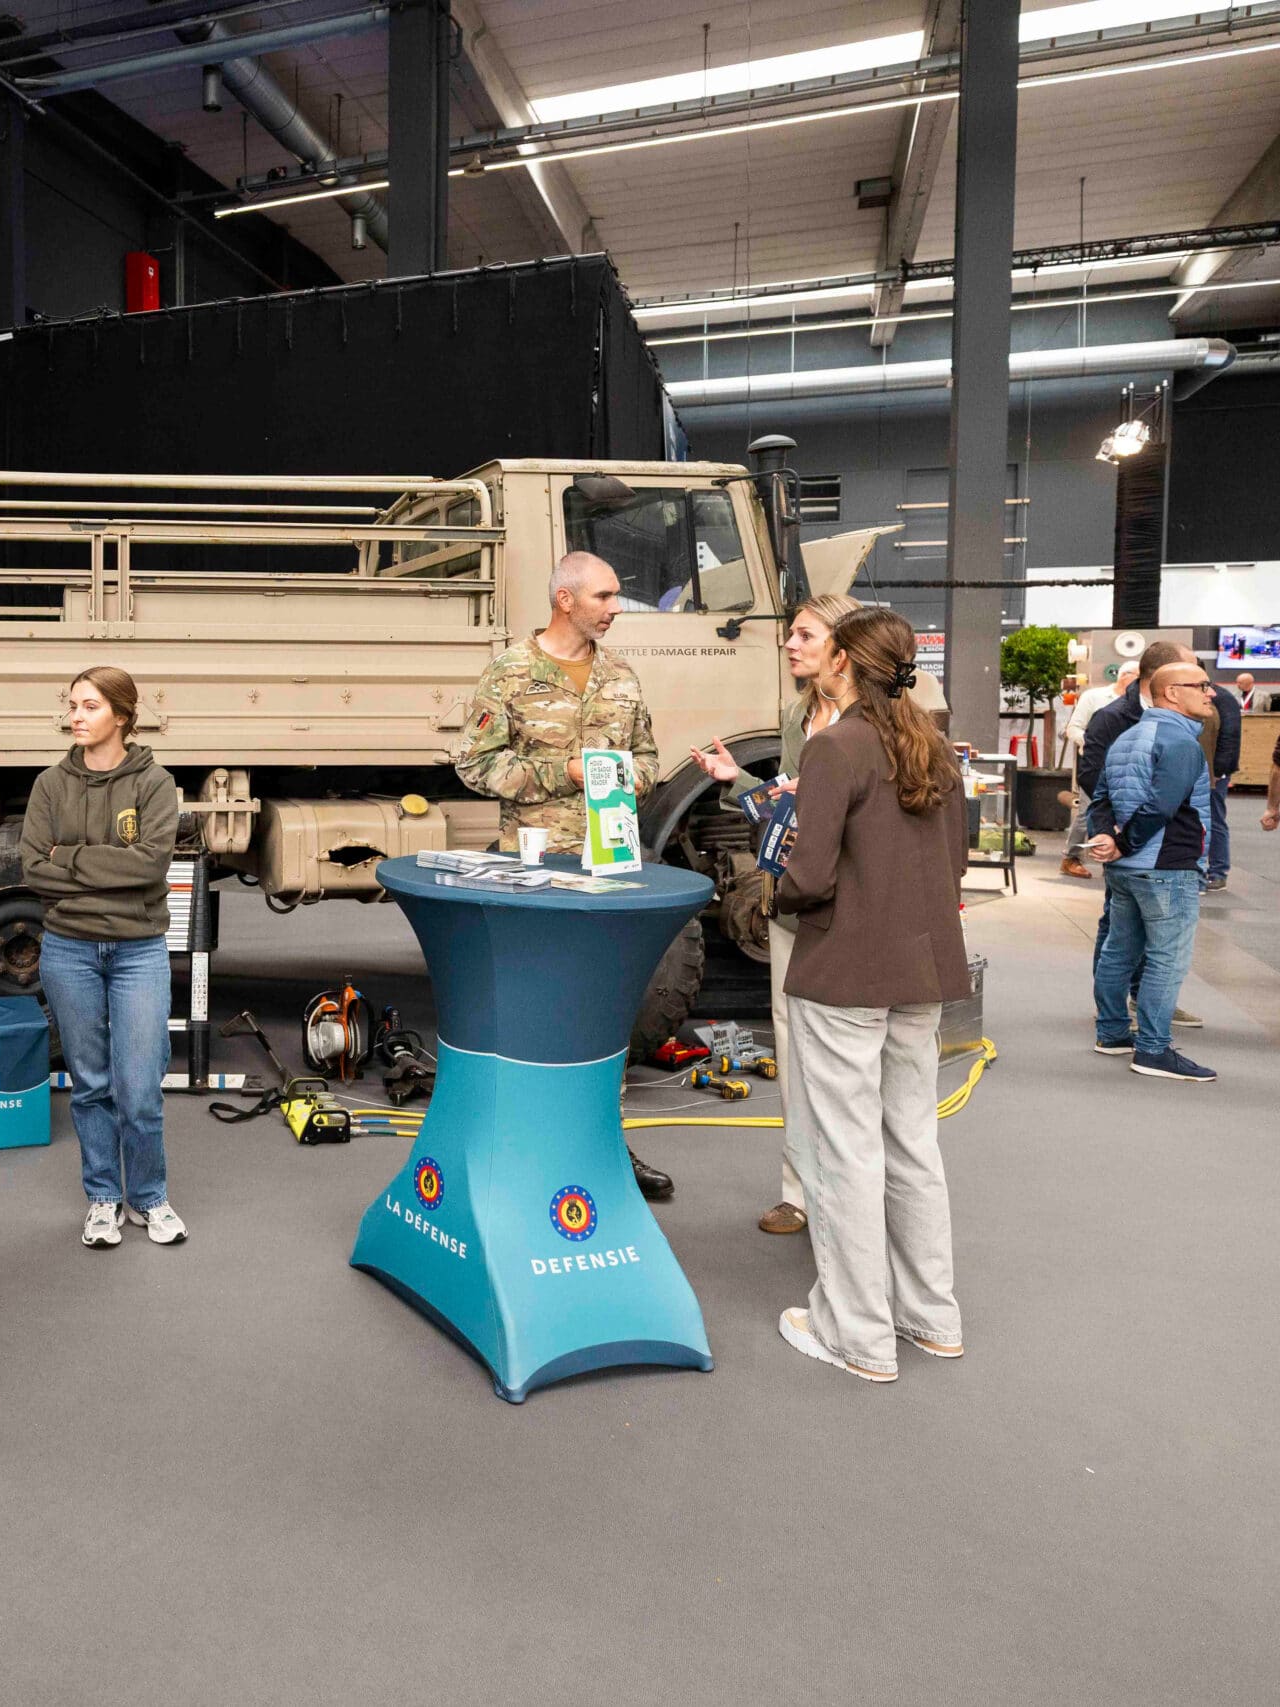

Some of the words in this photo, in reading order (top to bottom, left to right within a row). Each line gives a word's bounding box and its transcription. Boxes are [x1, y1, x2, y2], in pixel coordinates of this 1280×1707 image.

[651, 648, 698, 656] DAMAGE
[700, 648, 737, 656] REPAIR
[386, 1193, 401, 1217] LA
[405, 1208, 468, 1260] DÉFENSE
[530, 1245, 641, 1275] DEFENSIE
